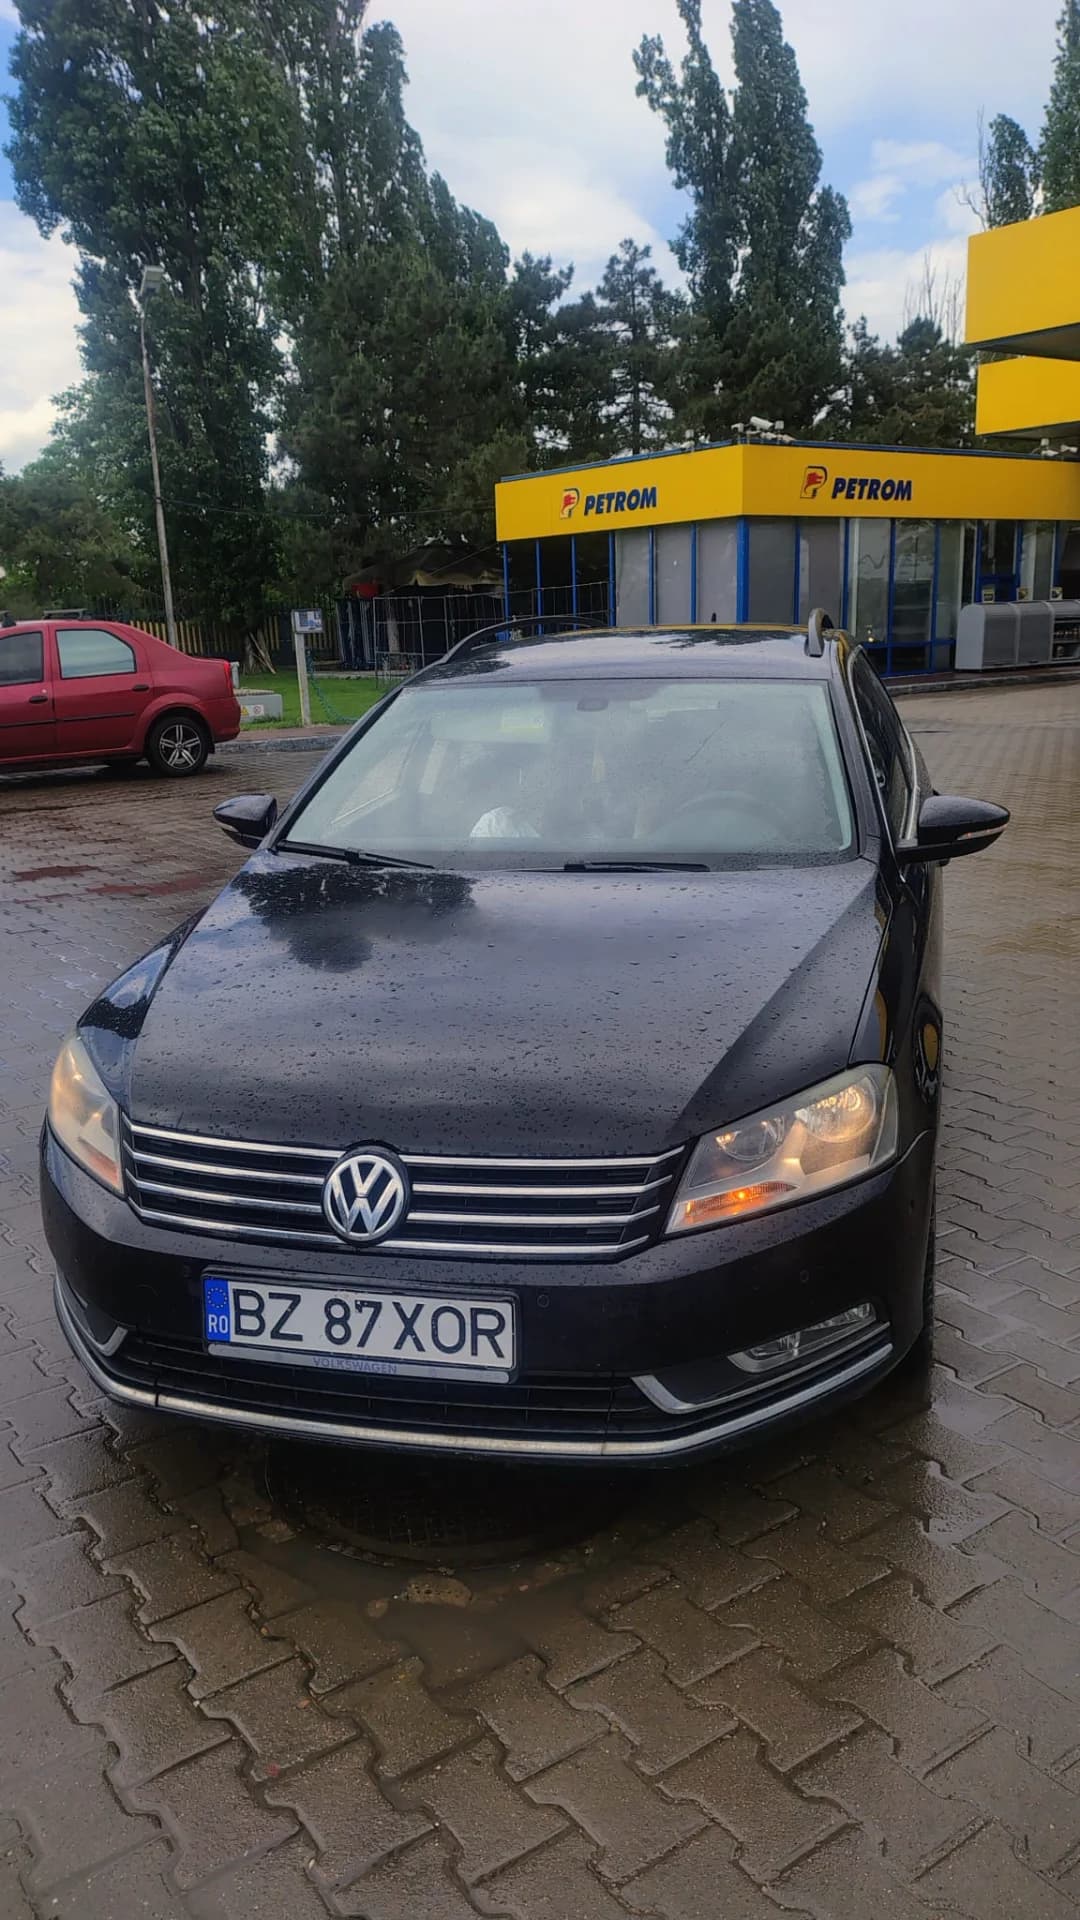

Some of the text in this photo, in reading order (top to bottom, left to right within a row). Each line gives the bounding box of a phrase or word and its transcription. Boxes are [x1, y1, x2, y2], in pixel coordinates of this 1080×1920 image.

[583, 486, 657, 516] PETROM
[831, 477, 913, 501] PETROM
[208, 1313, 229, 1334] RO
[232, 1288, 506, 1359] BZ 87 XOR
[312, 1356, 398, 1375] VOLKSWAGEN
